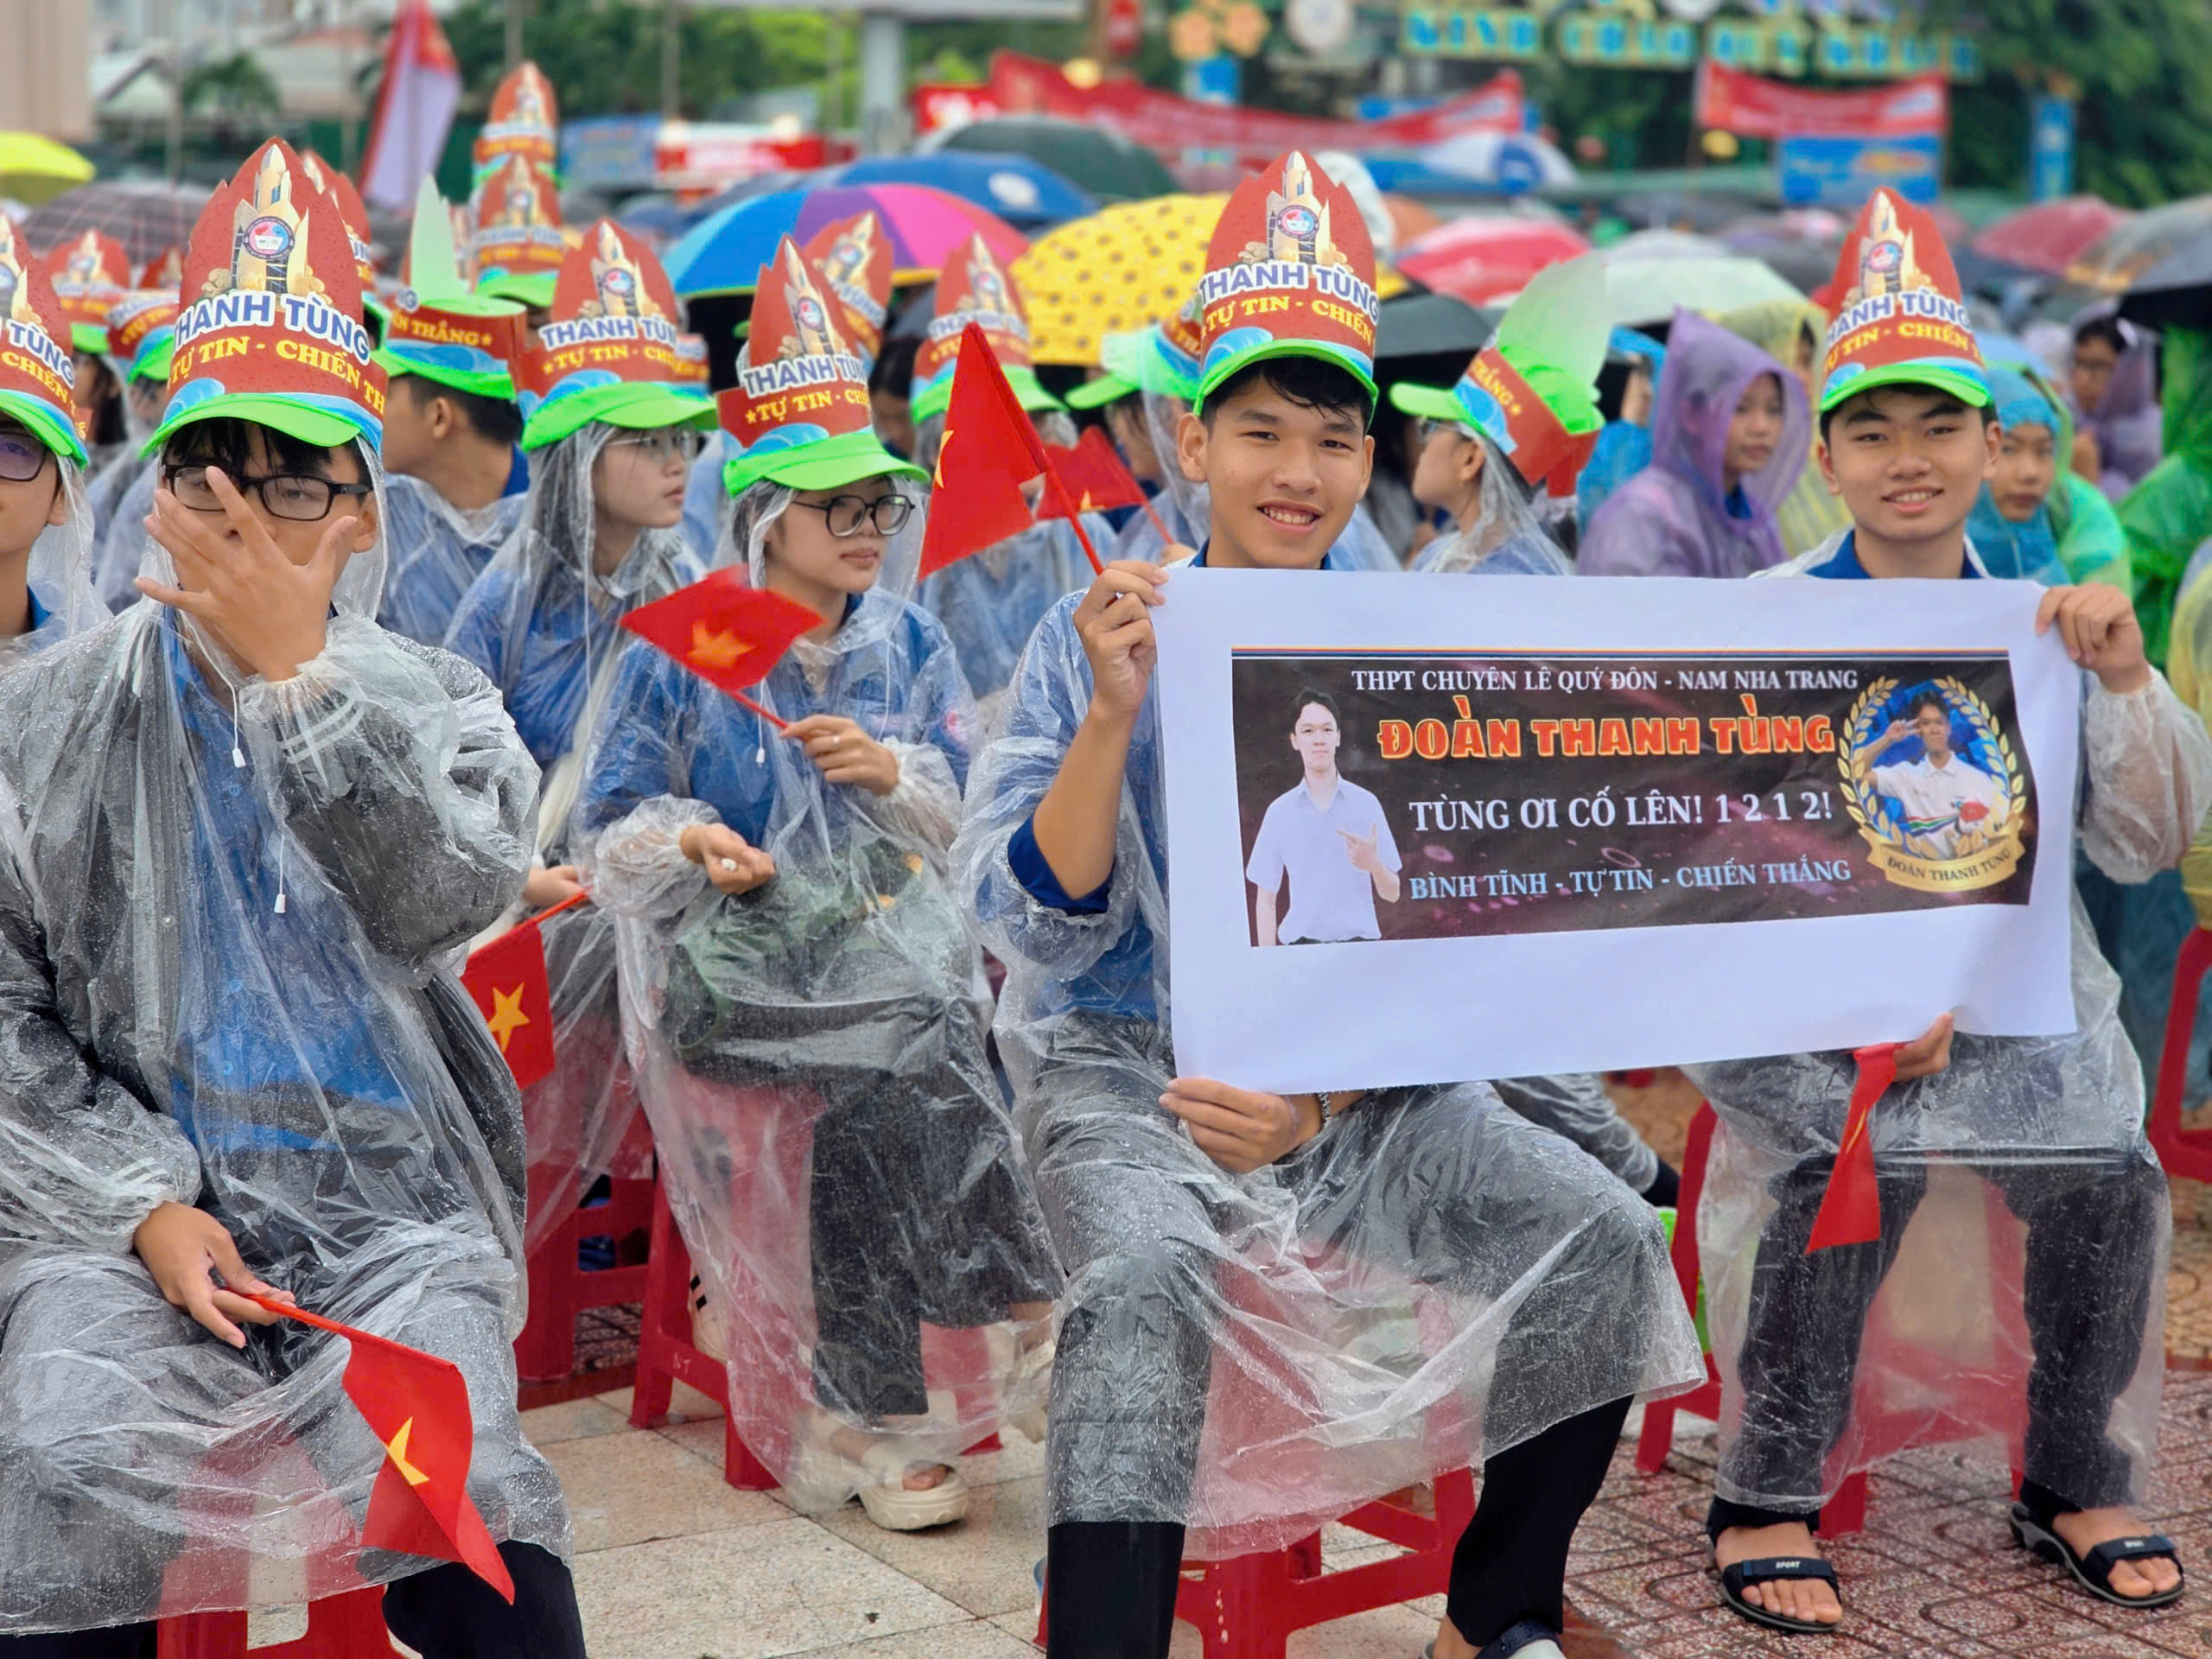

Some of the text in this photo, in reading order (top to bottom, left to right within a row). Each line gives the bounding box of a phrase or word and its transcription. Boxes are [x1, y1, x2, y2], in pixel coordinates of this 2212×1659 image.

[1199, 262, 1380, 324] THANH TÙNG
[283, 295, 370, 363] TÙNG
[541, 318, 637, 347] THANH
[1206, 301, 1237, 332] TỰ
[1241, 296, 1291, 315] TIN
[1312, 299, 1374, 346] CHIẾN
[1827, 295, 1892, 343] HANH
[1841, 327, 1879, 356] TIN
[1897, 321, 1969, 352] CHIẾN
[1, 351, 69, 404] CHIẾN
[8, 321, 74, 389] TÙNG
[171, 346, 195, 383] TỰ
[199, 336, 251, 364] TIN
[554, 348, 585, 369] TỰ
[589, 345, 629, 361] TIN
[744, 357, 836, 395] THANH
[756, 396, 788, 422] TỰ
[792, 390, 833, 412] TIN
[1351, 670, 1415, 690] THPT
[1421, 666, 1517, 691] CHUYÊN
[1524, 666, 1552, 690] LÊ
[1558, 666, 1605, 694] QUÝ
[1610, 666, 1657, 690] ĐÔN
[1678, 671, 1728, 690] NAM
[1734, 671, 1782, 690] NHA
[1785, 670, 1858, 690] TRANG
[1377, 693, 1836, 760] ĐOÀN THANH TÙNG
[1408, 785, 1833, 831] TÙNG ƠI CỐ LÊN! 1 2 1 2!
[1409, 872, 1478, 899] BÌNH
[1483, 869, 1548, 896] TĨNH
[1569, 868, 1607, 897] TỰ
[1609, 868, 1653, 892] TIN
[1676, 857, 1757, 888] CHIẾN
[1762, 854, 1852, 884] THẮNG
[1929, 864, 1980, 881] THANH
[1775, 1560, 1801, 1569] SPORT
